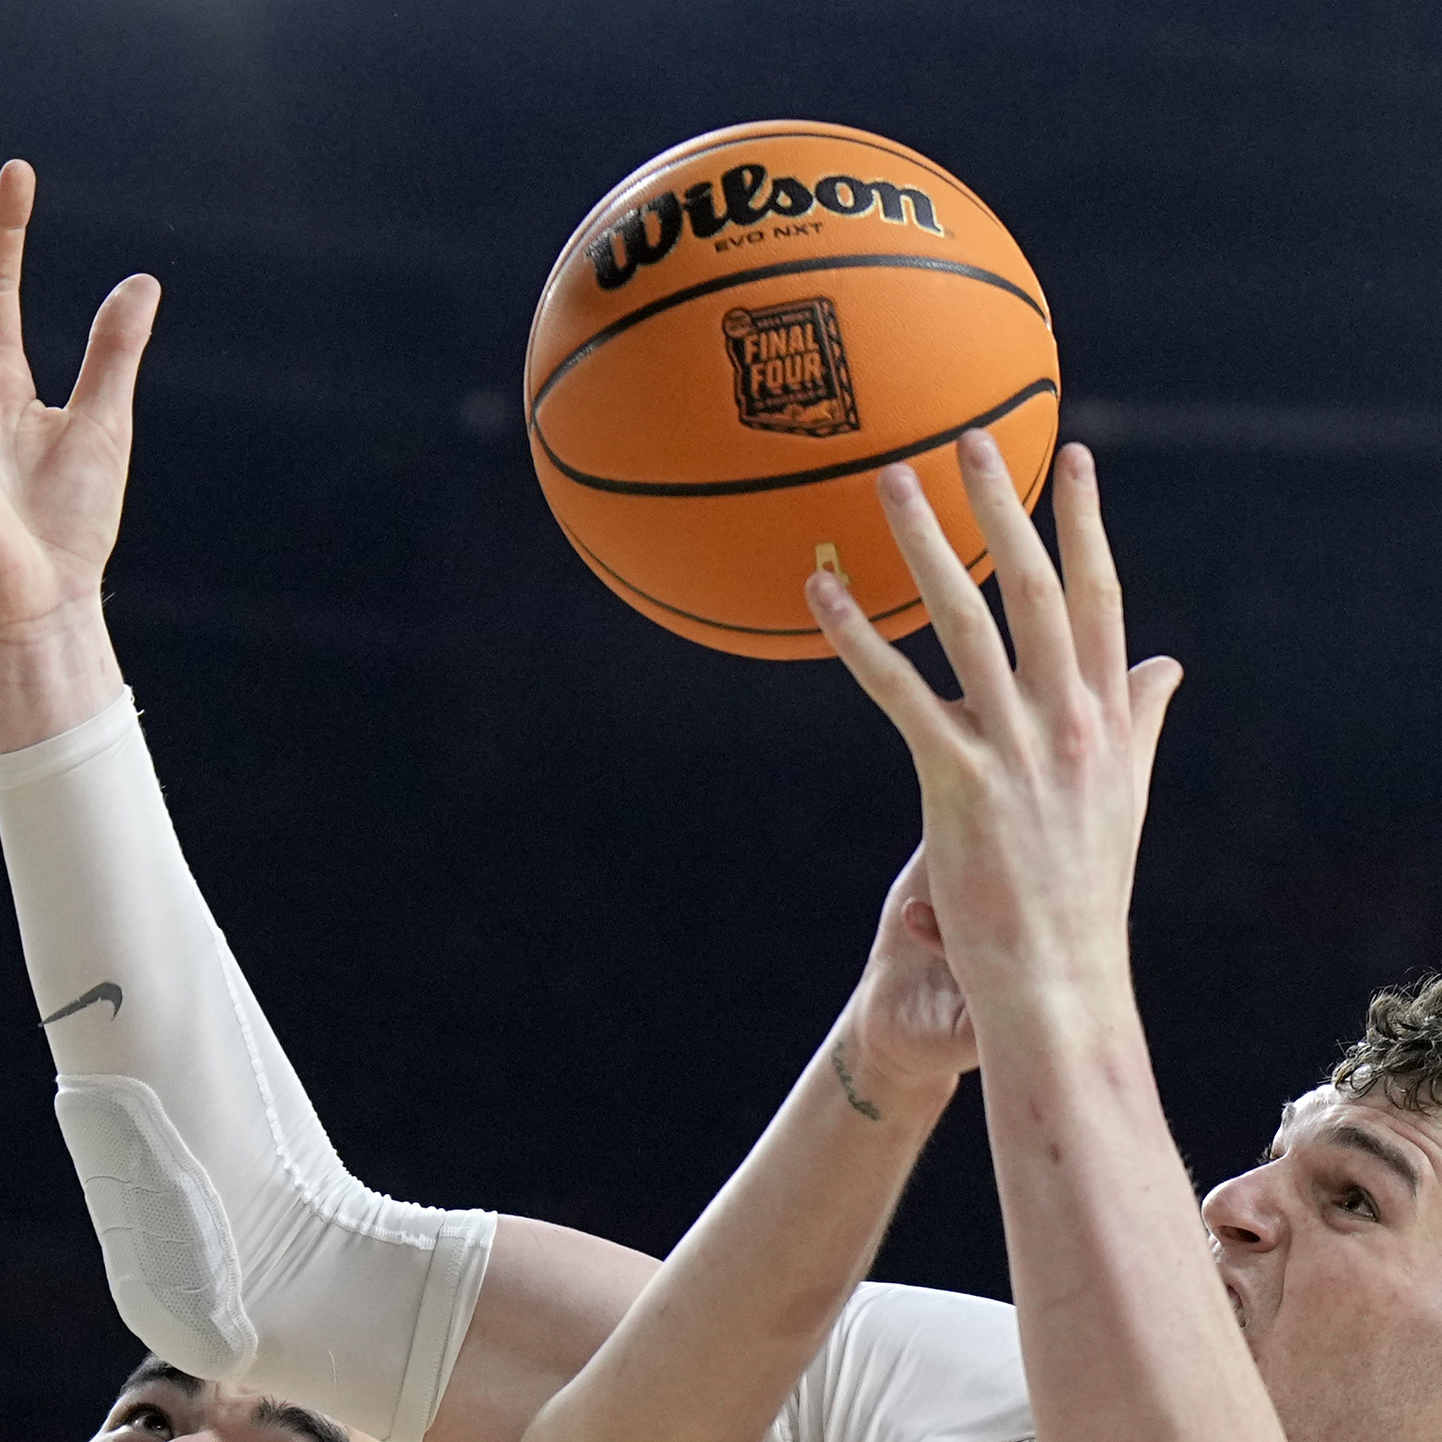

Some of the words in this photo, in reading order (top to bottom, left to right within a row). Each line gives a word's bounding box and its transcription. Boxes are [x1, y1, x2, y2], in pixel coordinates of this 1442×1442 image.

[584, 163, 946, 292] Wilson
[715, 230, 765, 252] EVO
[773, 222, 823, 239] NXT
[744, 322, 820, 365] FINAL
[750, 352, 824, 399] FOUR
